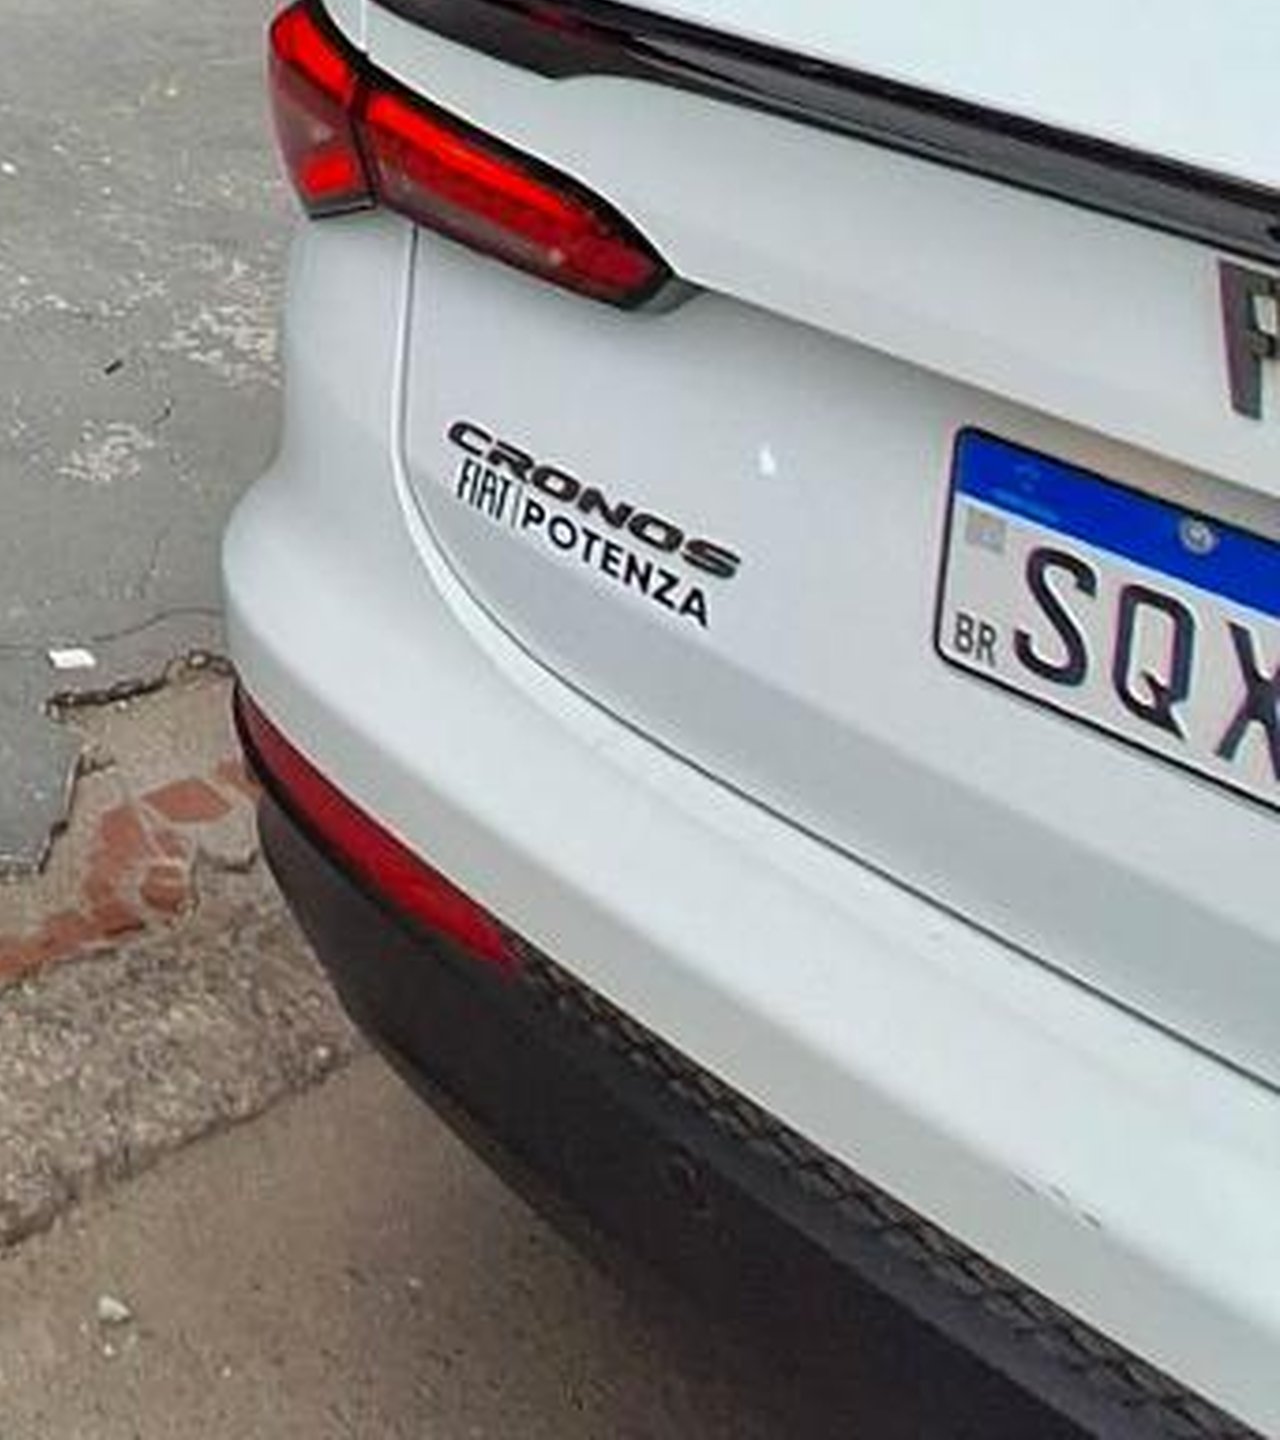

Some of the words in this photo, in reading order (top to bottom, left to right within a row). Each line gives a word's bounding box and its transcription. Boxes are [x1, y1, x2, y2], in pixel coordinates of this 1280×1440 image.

[448, 421, 741, 579] CRONOS
[457, 457, 512, 521] FIAT
[521, 497, 709, 629] POTENZA
[953, 612, 998, 668] BR
